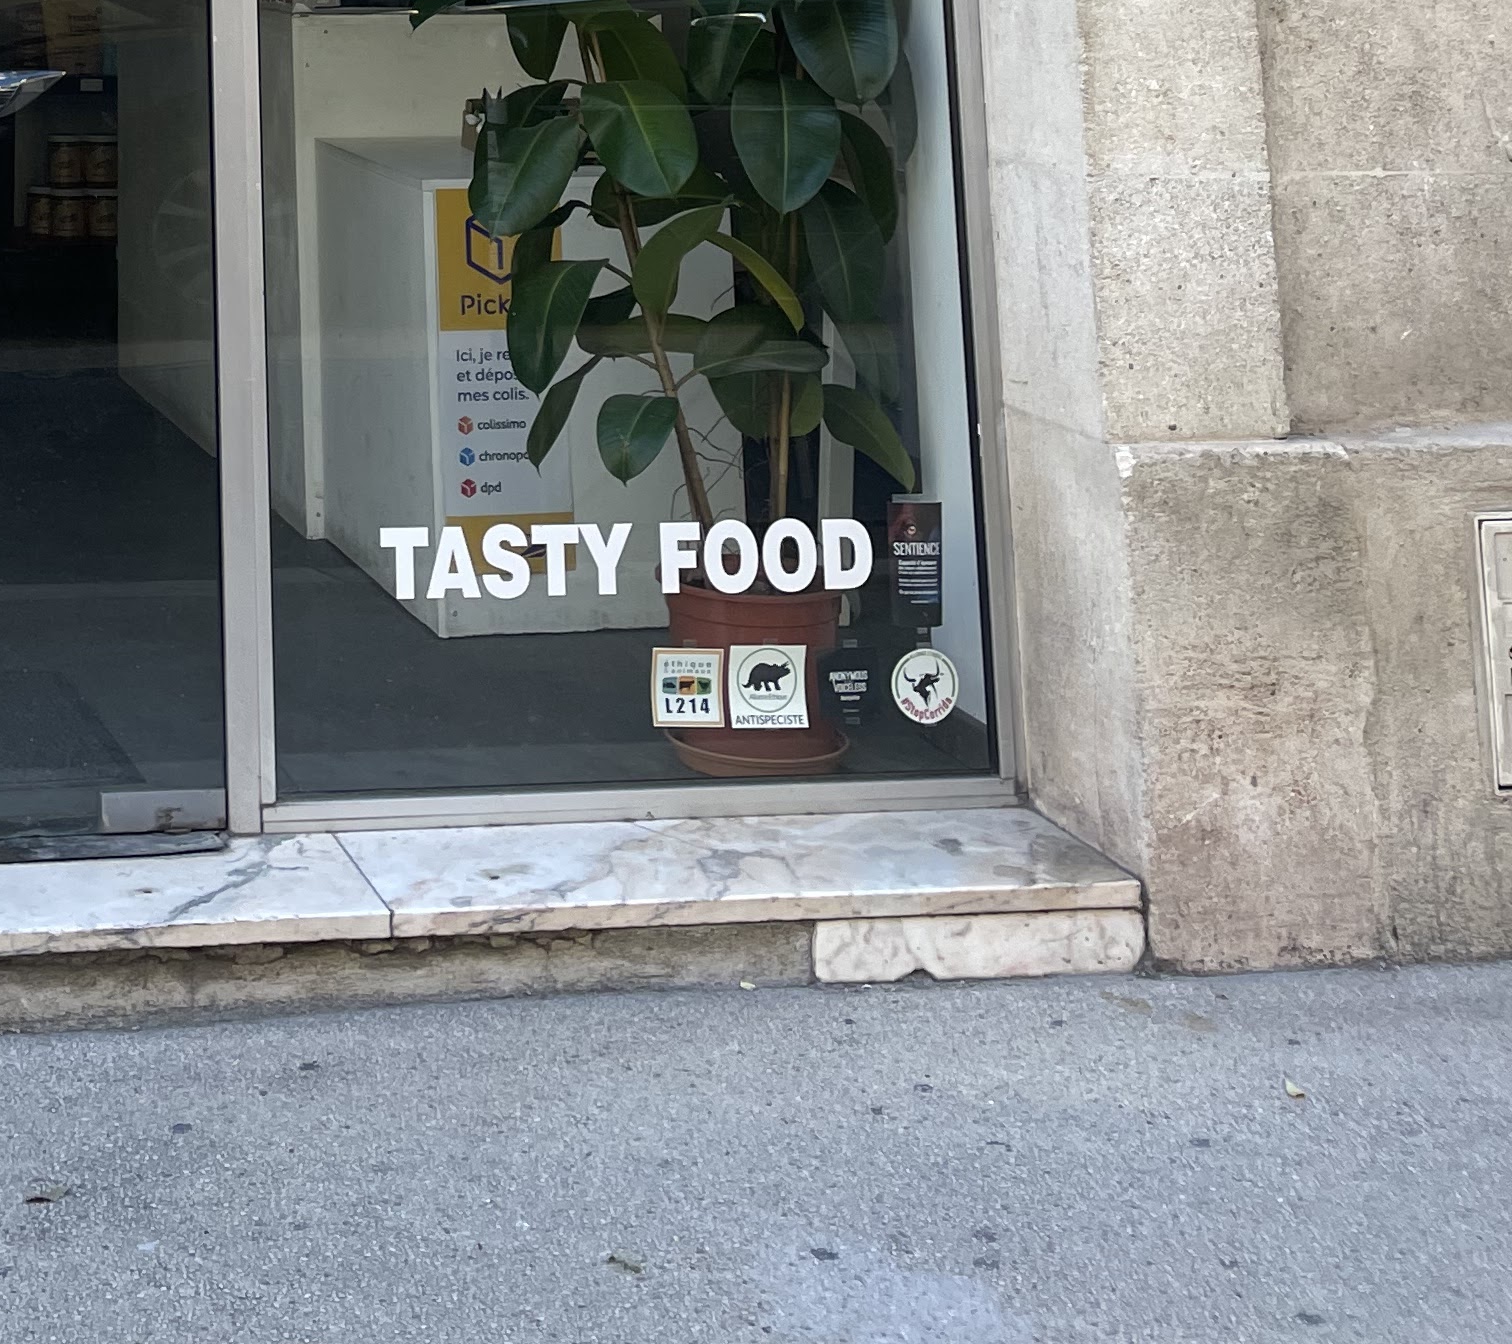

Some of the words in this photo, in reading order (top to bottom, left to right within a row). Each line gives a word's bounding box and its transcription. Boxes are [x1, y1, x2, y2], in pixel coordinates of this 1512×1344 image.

[456, 349, 476, 363] Ici,
[478, 349, 493, 365] je
[456, 370, 472, 382] et
[475, 367, 519, 387] dépo
[457, 391, 489, 402] mes
[477, 419, 526, 430] colissimo
[480, 482, 502, 495] dpd
[379, 521, 632, 600] TASTY
[660, 517, 875, 595] FOOD
[665, 697, 711, 714] L214
[735, 714, 805, 725] ANTISPECISTE
